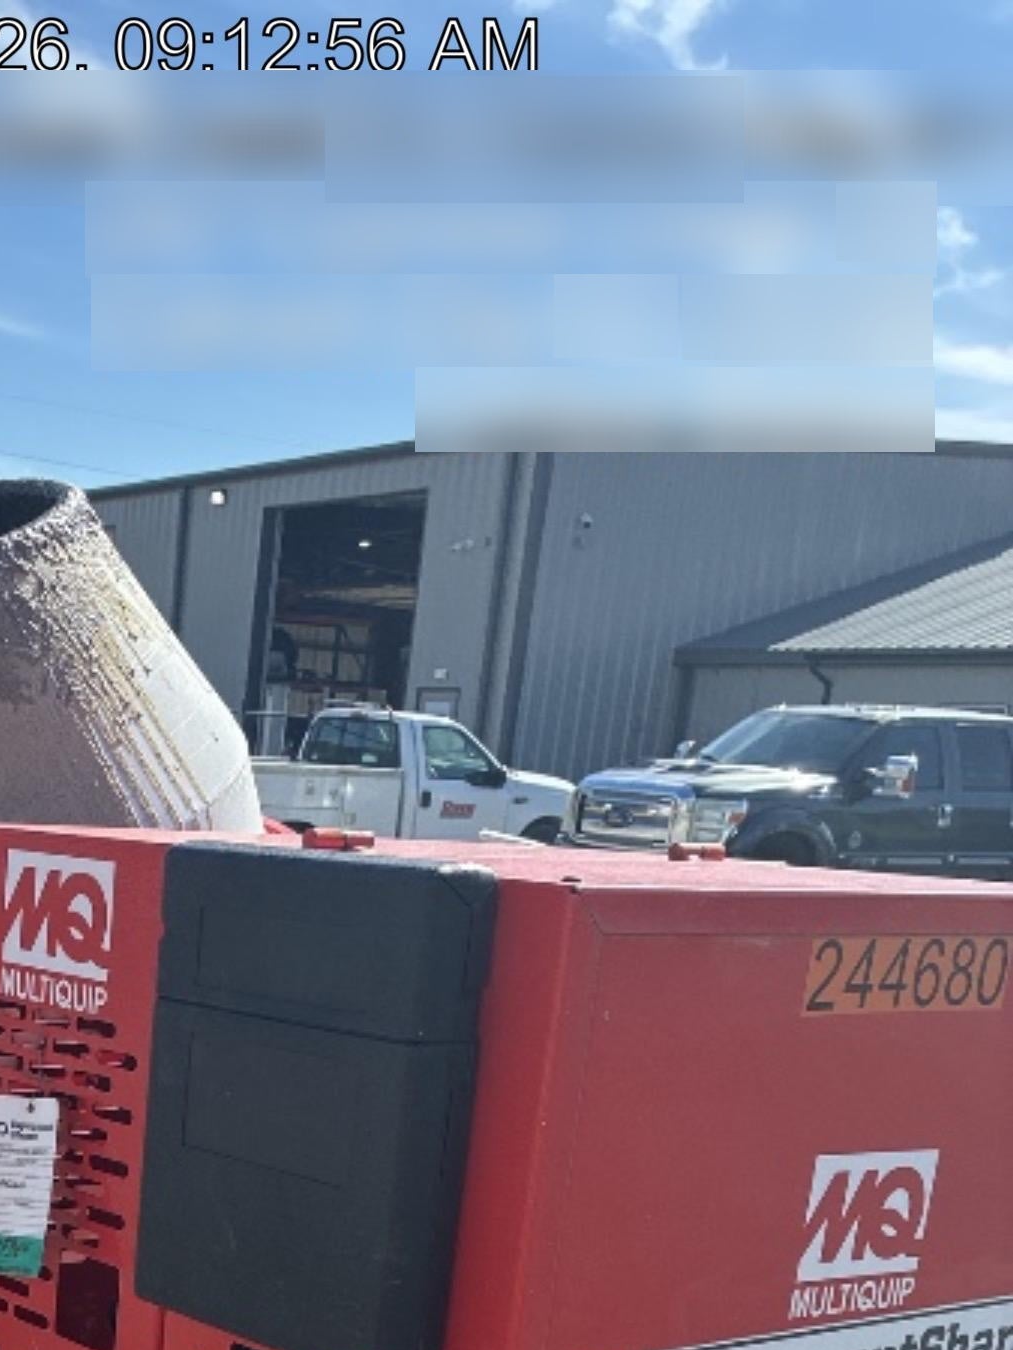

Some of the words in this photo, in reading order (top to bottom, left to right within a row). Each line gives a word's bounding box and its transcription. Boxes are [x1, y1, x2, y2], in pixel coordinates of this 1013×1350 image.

[0, 850, 115, 974] MQ
[0, 965, 109, 1015] MULTIQUIP
[806, 937, 1009, 1011] 244680
[796, 1150, 938, 1280] MQ
[788, 1276, 916, 1320] MULTIQUIP
